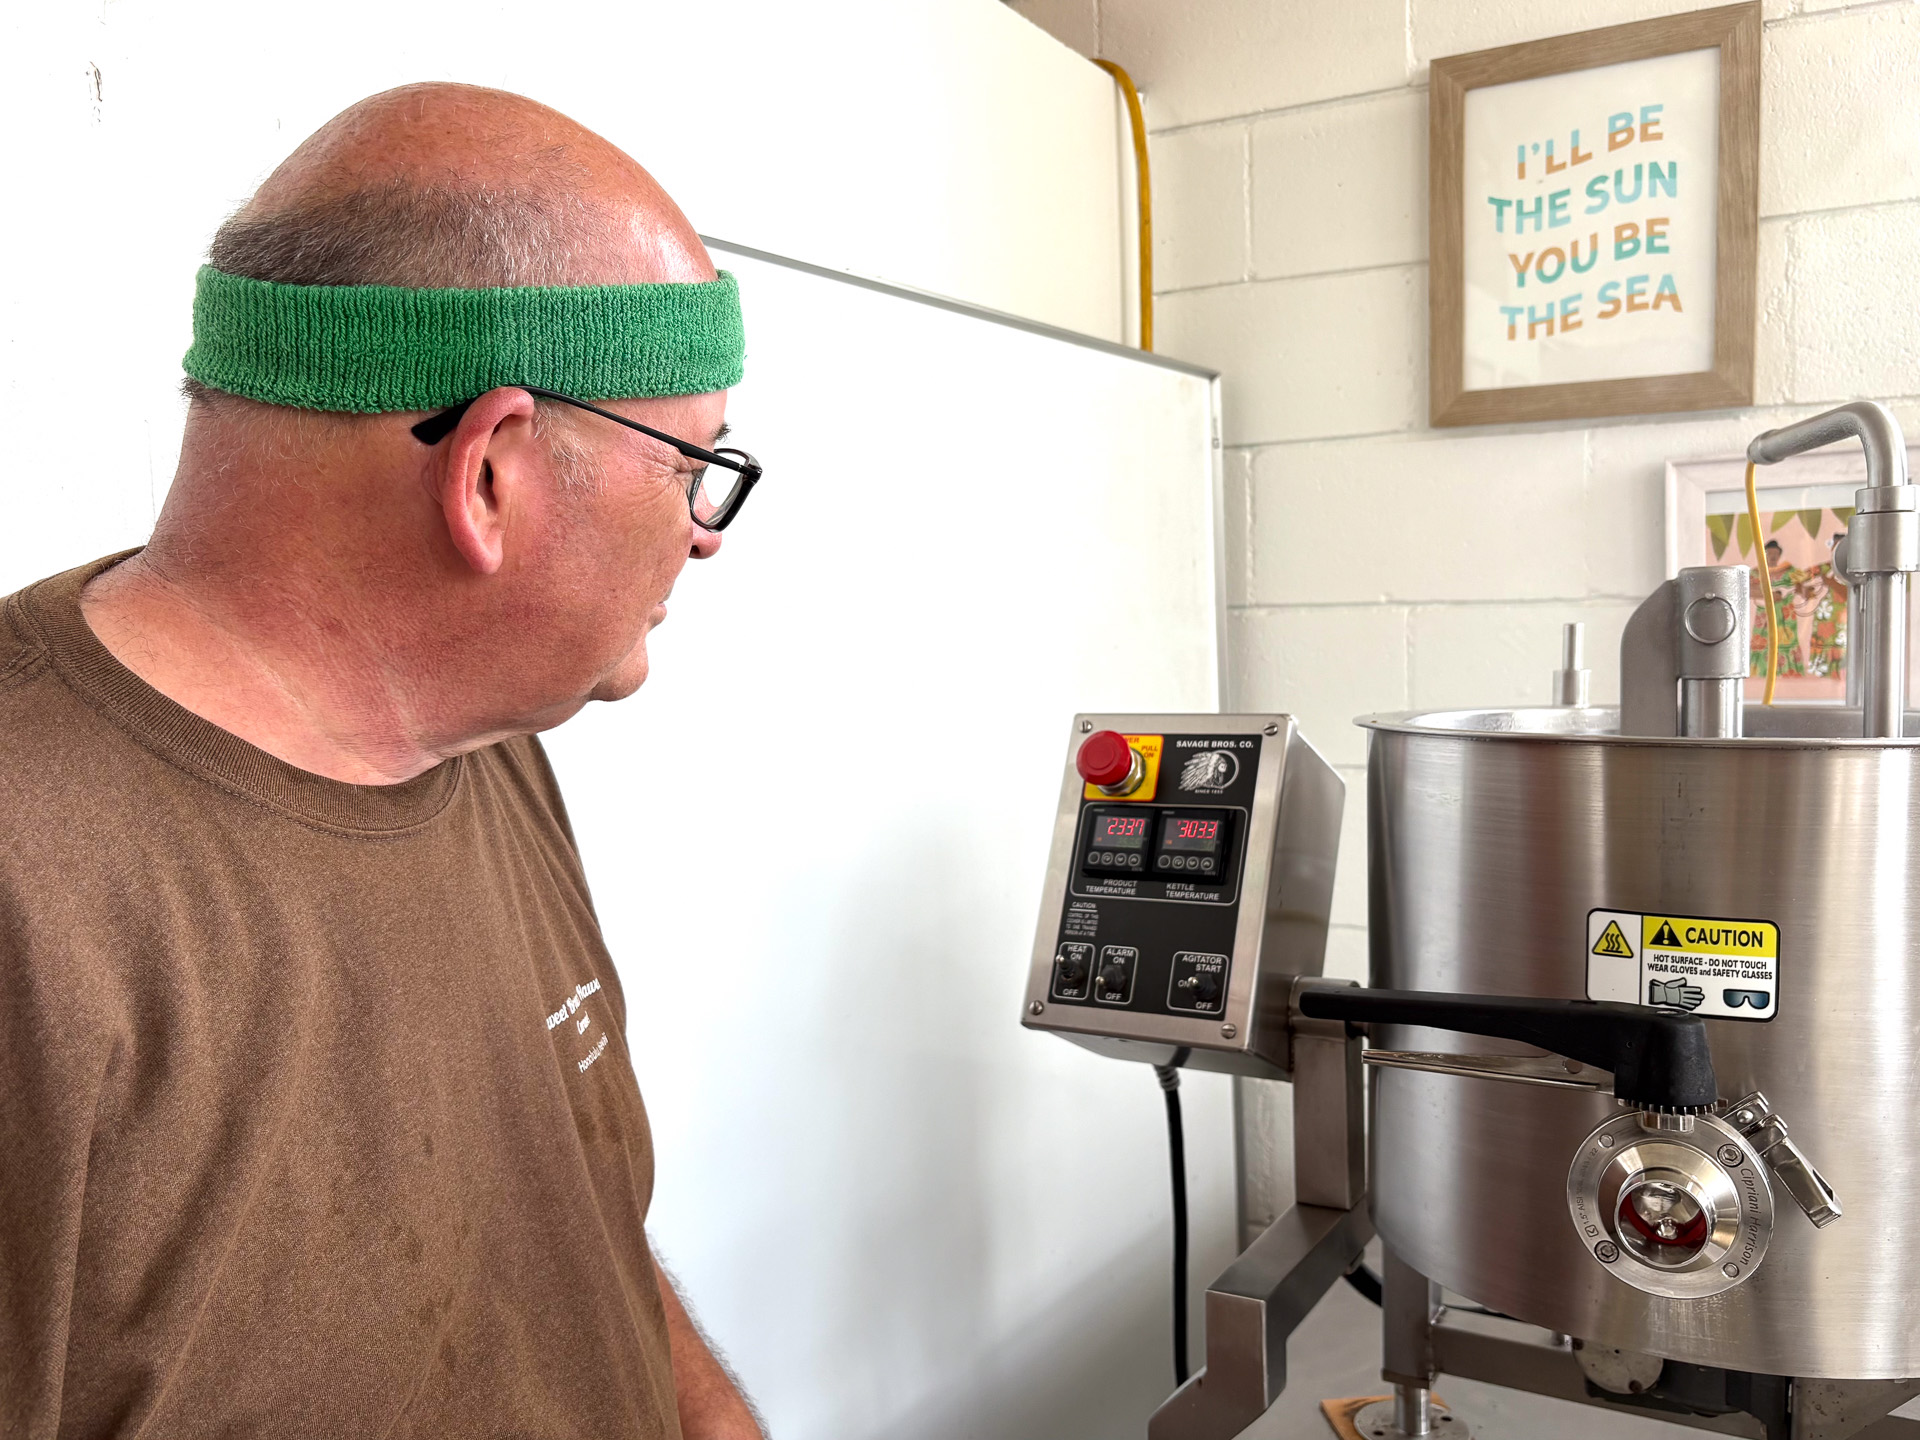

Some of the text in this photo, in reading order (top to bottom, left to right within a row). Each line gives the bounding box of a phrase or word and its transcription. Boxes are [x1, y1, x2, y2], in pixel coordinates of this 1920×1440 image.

[1517, 104, 1664, 180] I'LL BE
[1488, 161, 1678, 234] THE SUN
[1508, 217, 1670, 288] YOU BE
[1500, 274, 1683, 341] THE SEA
[1176, 740, 1210, 748] SAVAGE
[1239, 741, 1254, 749] CO.
[1103, 879, 1138, 888] PRODUCT
[1166, 883, 1195, 891] KETTLE
[1085, 886, 1137, 896] TEMPERATURE
[1165, 891, 1220, 900] TEMPERATURE
[1072, 901, 1097, 909] CAUTION
[1685, 927, 1764, 948] CAUTION
[1068, 945, 1087, 953] HEAT
[1106, 948, 1134, 957] ALARM
[1070, 952, 1083, 961] ON
[1113, 956, 1125, 964] ON
[1182, 955, 1222, 965] AGITATOR
[1653, 954, 1670, 964] HOT
[1670, 956, 1703, 966] SURFACE
[1709, 958, 1720, 967] DO
[1722, 959, 1738, 968] NOT
[1740, 960, 1767, 970] TOUCH
[1196, 964, 1222, 973] START
[1647, 962, 1773, 980] WEAR GLOVES and SAFETY GLASSES
[1178, 980, 1190, 988] ON
[1063, 988, 1079, 997] OFF
[1105, 993, 1122, 1001] OFF
[1195, 1001, 1213, 1010] OFF
[1740, 1168, 1761, 1266] Cipriani Harrison
